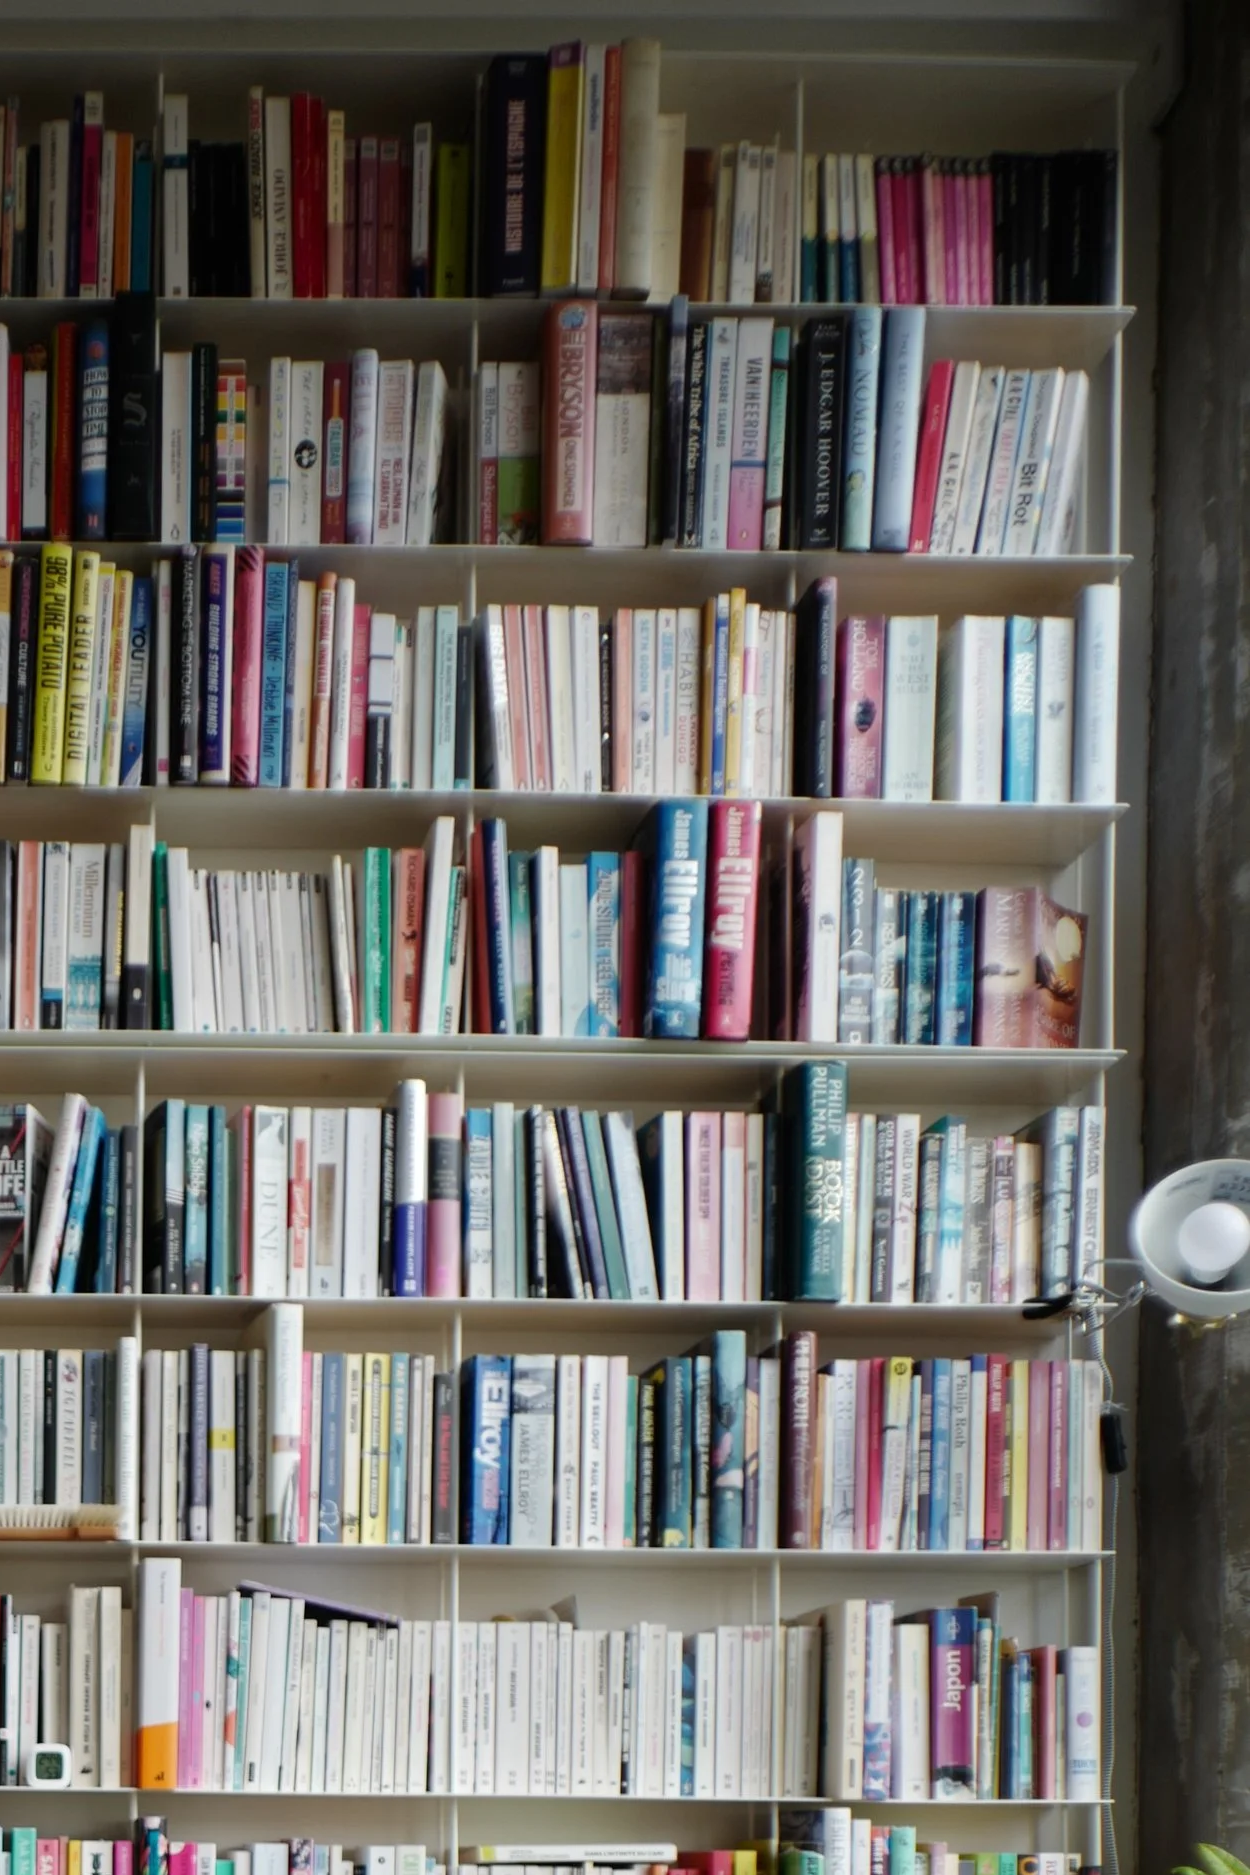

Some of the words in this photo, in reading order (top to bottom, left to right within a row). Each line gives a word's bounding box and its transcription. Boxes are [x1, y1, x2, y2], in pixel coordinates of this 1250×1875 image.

[692, 326, 705, 348] The
[690, 351, 705, 384] White
[484, 387, 496, 406] Bill
[559, 346, 584, 439] BRYSON
[689, 387, 703, 413] Tribe
[816, 367, 835, 433] EDGAR
[852, 369, 872, 456] NOMAD
[482, 410, 495, 445] Bryson
[688, 416, 701, 426] of
[742, 388, 762, 458] HEERDEN
[687, 429, 701, 469] Africa
[481, 465, 495, 530] Shakespeare
[814, 437, 832, 516] HOOVER
[1020, 462, 1039, 489] Bit
[1012, 493, 1034, 527] Rot
[45, 556, 67, 588] 98%
[265, 571, 284, 611] BRAND
[44, 593, 67, 627] PURE
[208, 604, 220, 651] BUILDING
[41, 630, 66, 689] POTATO
[72, 614, 93, 681] LEADER
[265, 614, 284, 662] THINKING
[128, 623, 147, 709] YOUTILITY
[207, 654, 219, 692] STRONG
[678, 652, 694, 710] HABIT
[206, 696, 218, 735] BRANDS
[264, 675, 281, 711] Debbie
[69, 695, 89, 760] DIGITAL
[263, 714, 279, 757] Millman
[672, 809, 692, 859] James
[726, 807, 745, 857] James
[83, 860, 102, 939] Millennium
[658, 860, 699, 948] Ellroy
[710, 858, 752, 950] Ellroy
[810, 1067, 828, 1147] PULLMAN
[827, 1079, 841, 1135] PHILIP
[821, 1159, 841, 1223] BOOK
[258, 1181, 278, 1260] DUNE
[590, 1383, 600, 1400] THE
[474, 1377, 506, 1470] Ellroy
[518, 1423, 529, 1463] JAMES
[590, 1404, 600, 1450] SELLOUT
[518, 1470, 530, 1516] ELLROY
[589, 1461, 599, 1485] PAUL
[588, 1488, 598, 1526] BEATTY
[943, 1649, 963, 1711] Japon
